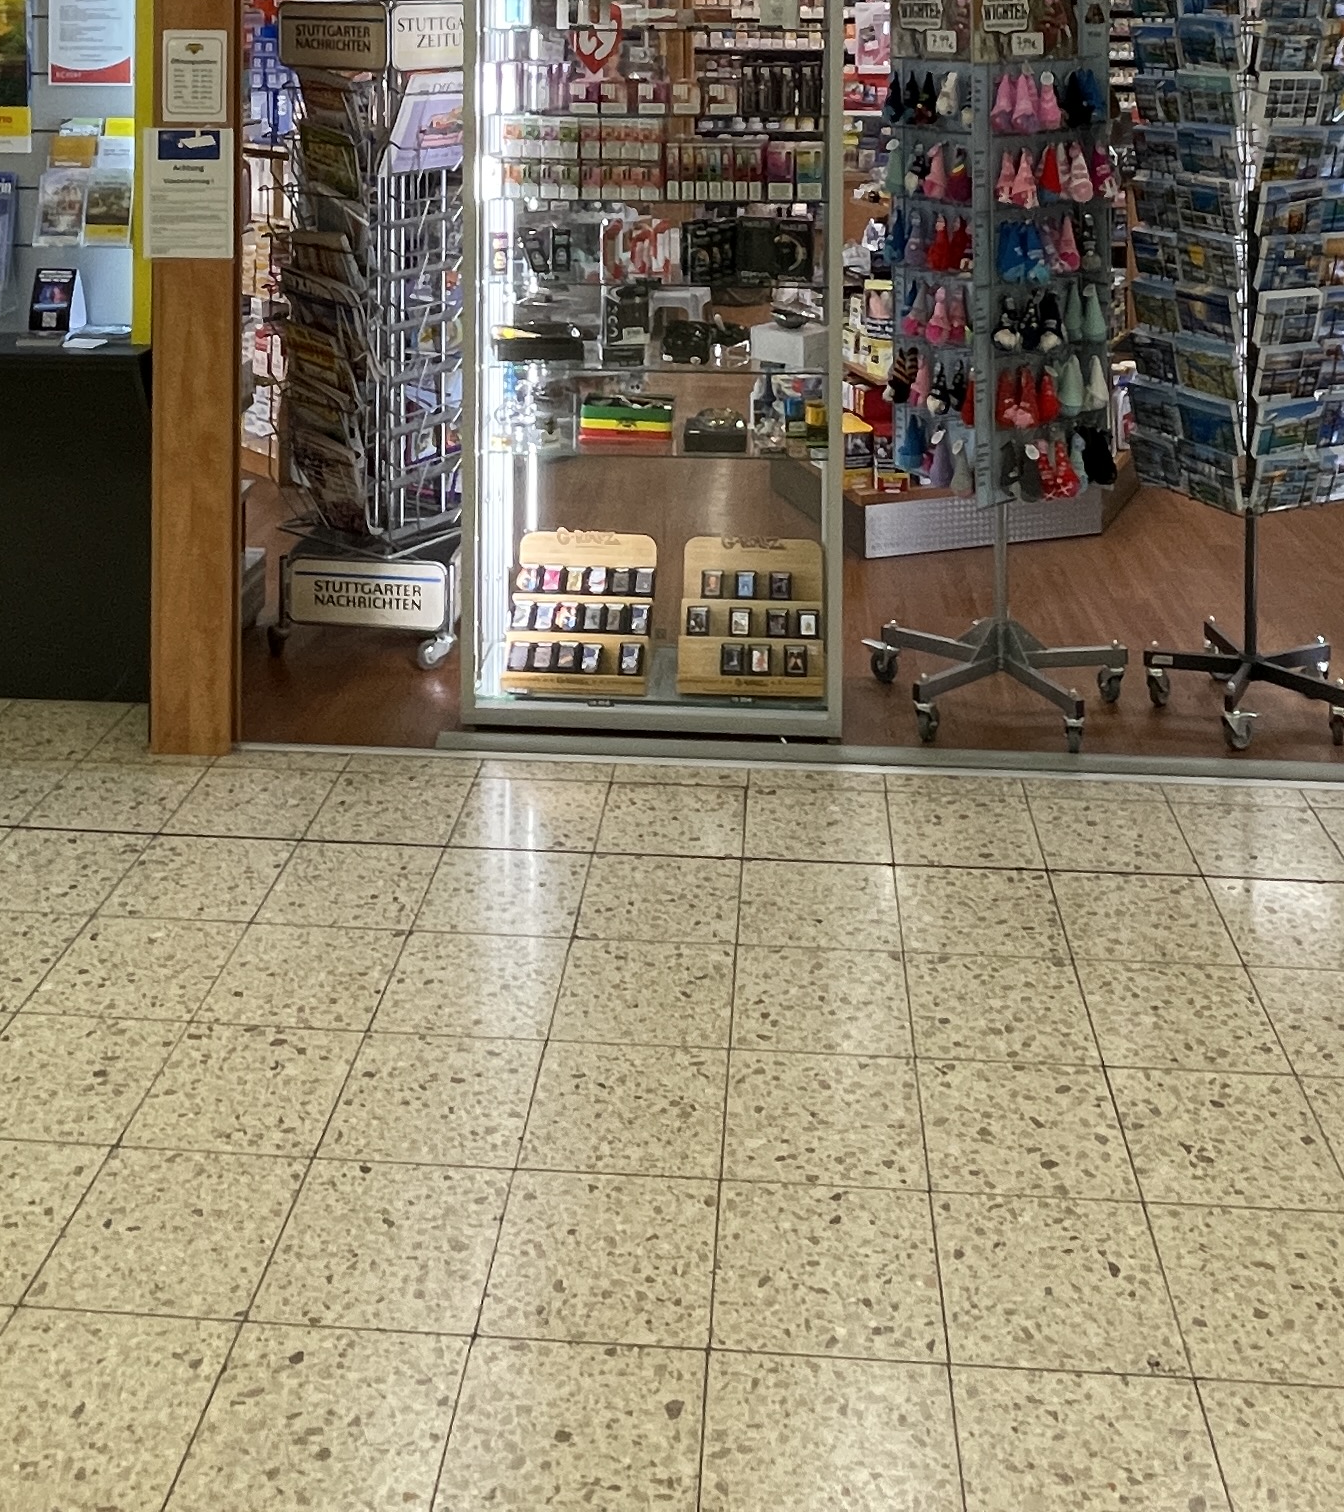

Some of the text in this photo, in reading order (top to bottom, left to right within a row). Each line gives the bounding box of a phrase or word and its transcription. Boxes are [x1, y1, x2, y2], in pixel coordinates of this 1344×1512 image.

[295, 24, 371, 38] STUTTGARTER
[295, 38, 371, 53] NACHRICHTEN
[314, 580, 422, 596] STUTTGARTER
[314, 593, 422, 611] NACHRICHTEN
